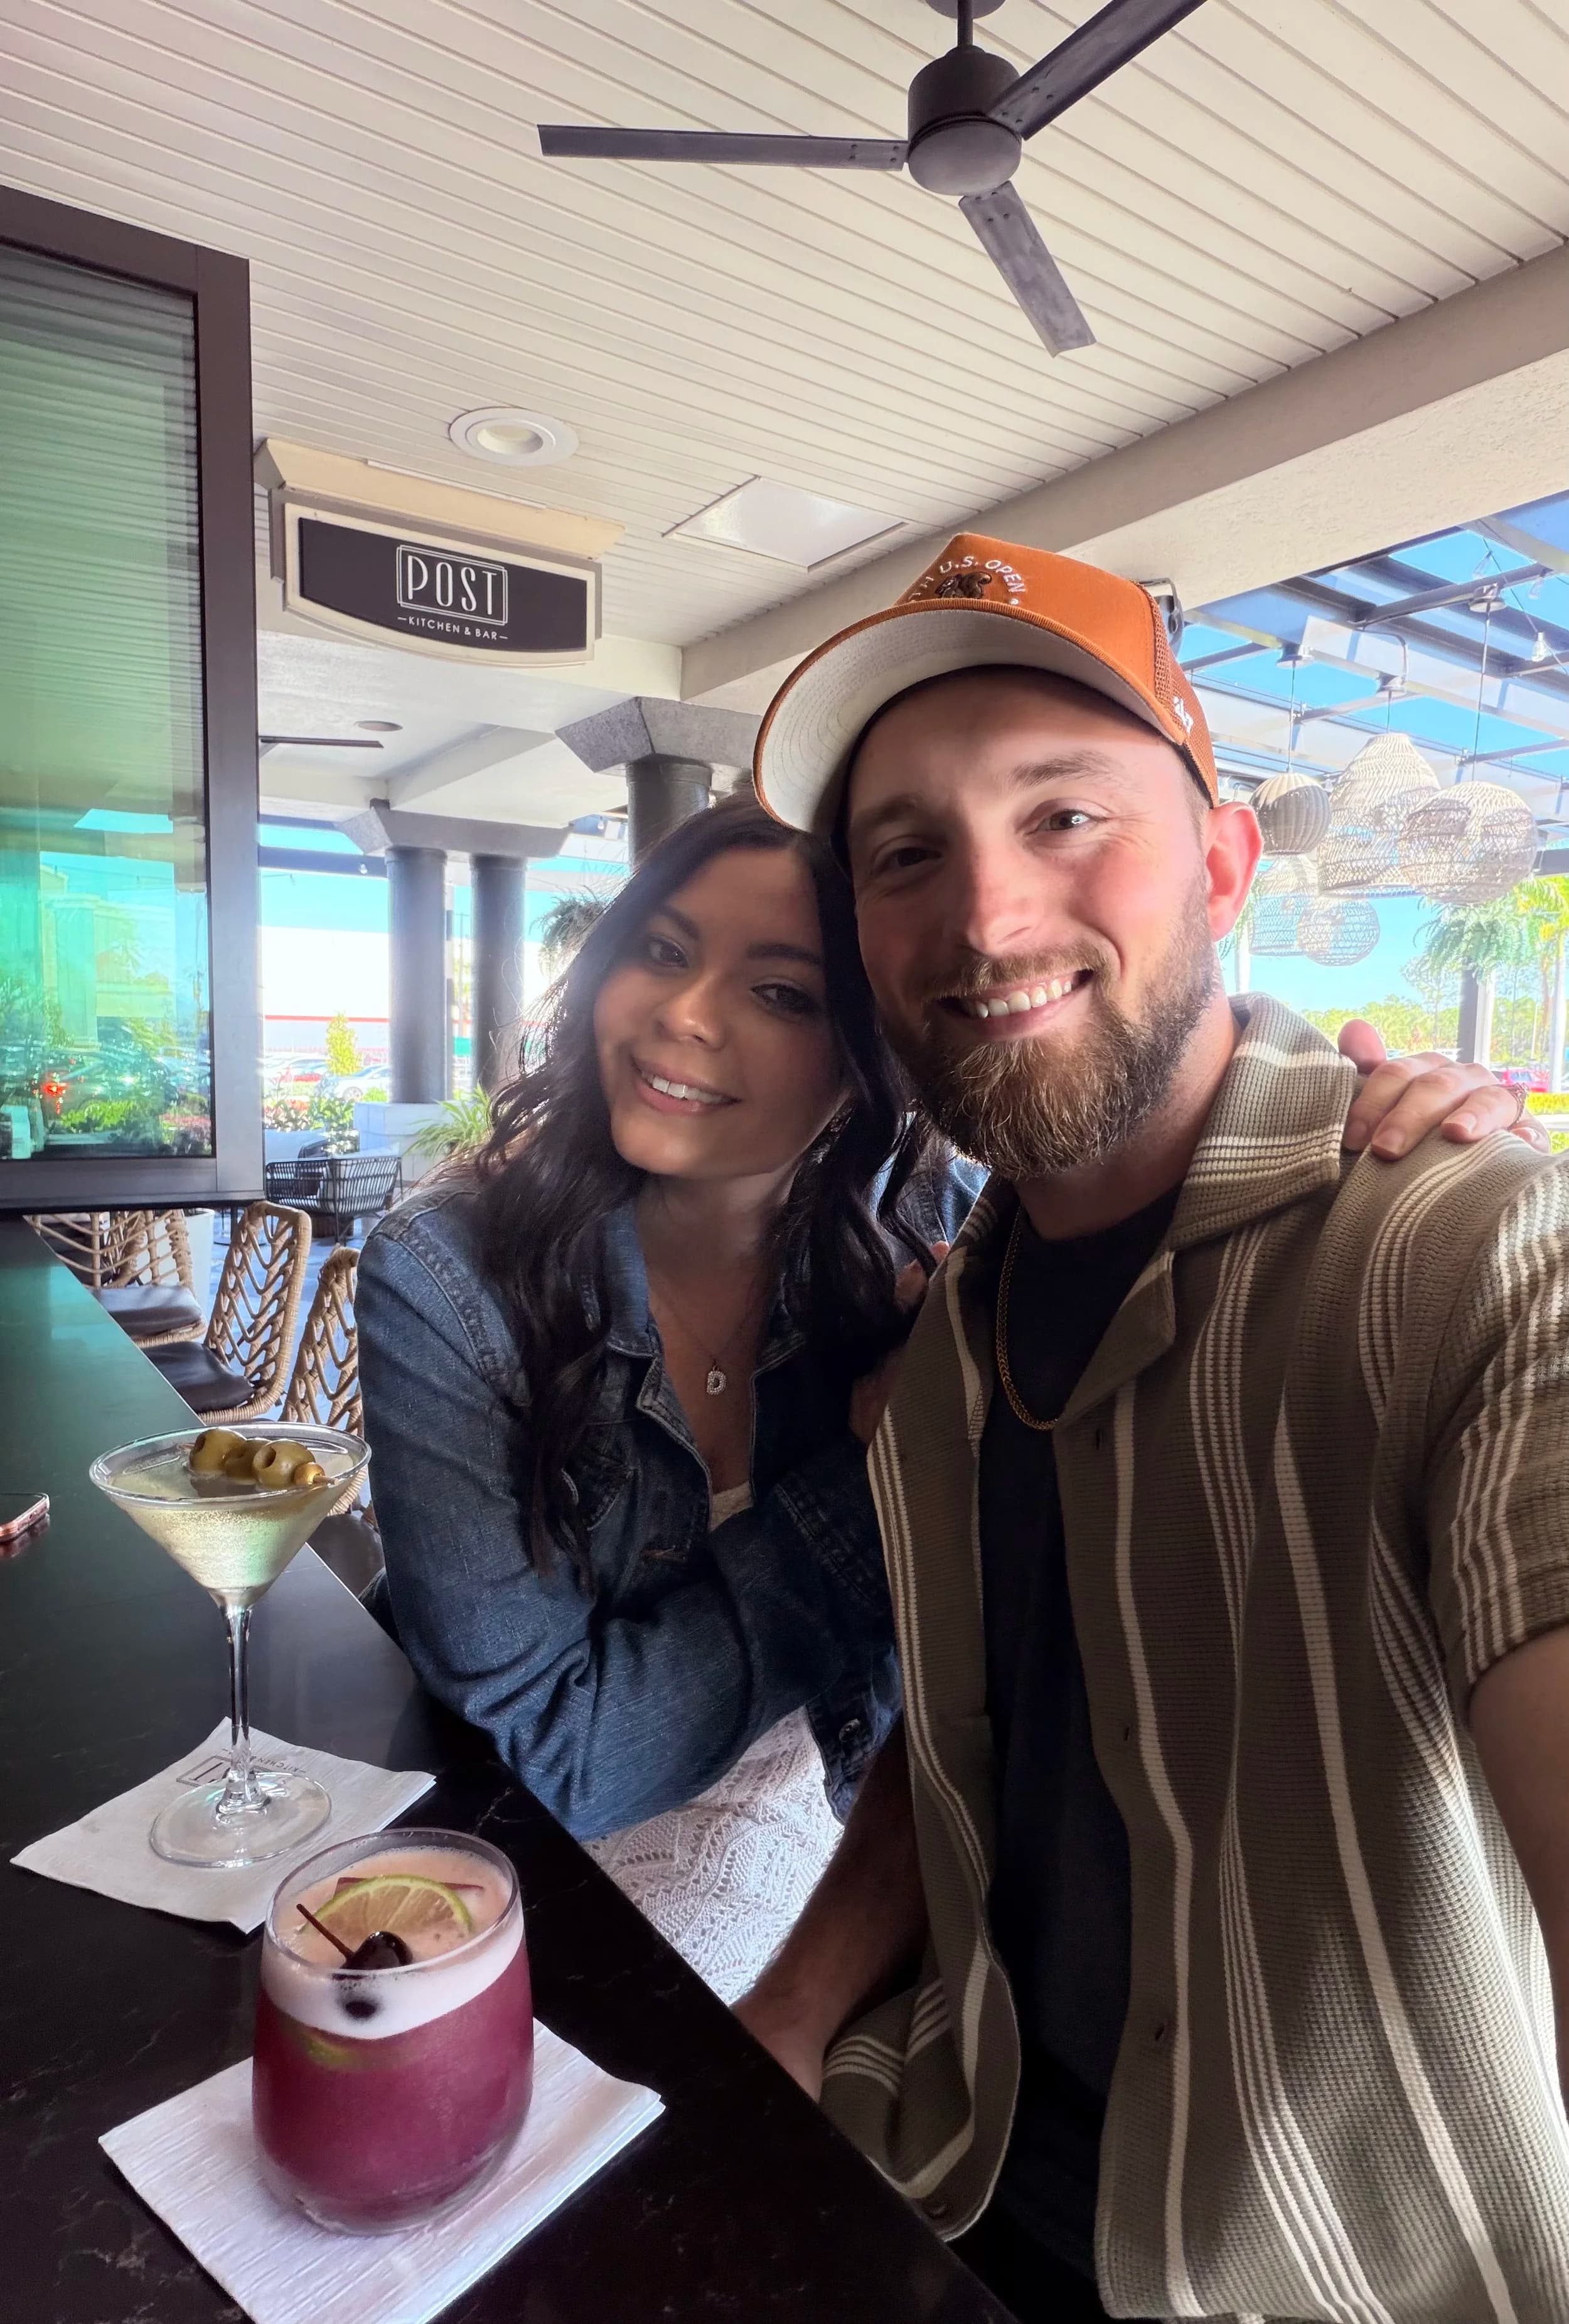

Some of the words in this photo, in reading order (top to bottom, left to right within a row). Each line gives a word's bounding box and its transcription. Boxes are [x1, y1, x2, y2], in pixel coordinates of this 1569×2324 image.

[408, 555, 497, 615] POST
[939, 556, 979, 574] U.S.
[985, 559, 1026, 593] OPEN
[409, 616, 460, 633] KITCHEN
[464, 627, 471, 636] &
[475, 628, 498, 640] BAR
[258, 1757, 299, 1772] KITCHEN
